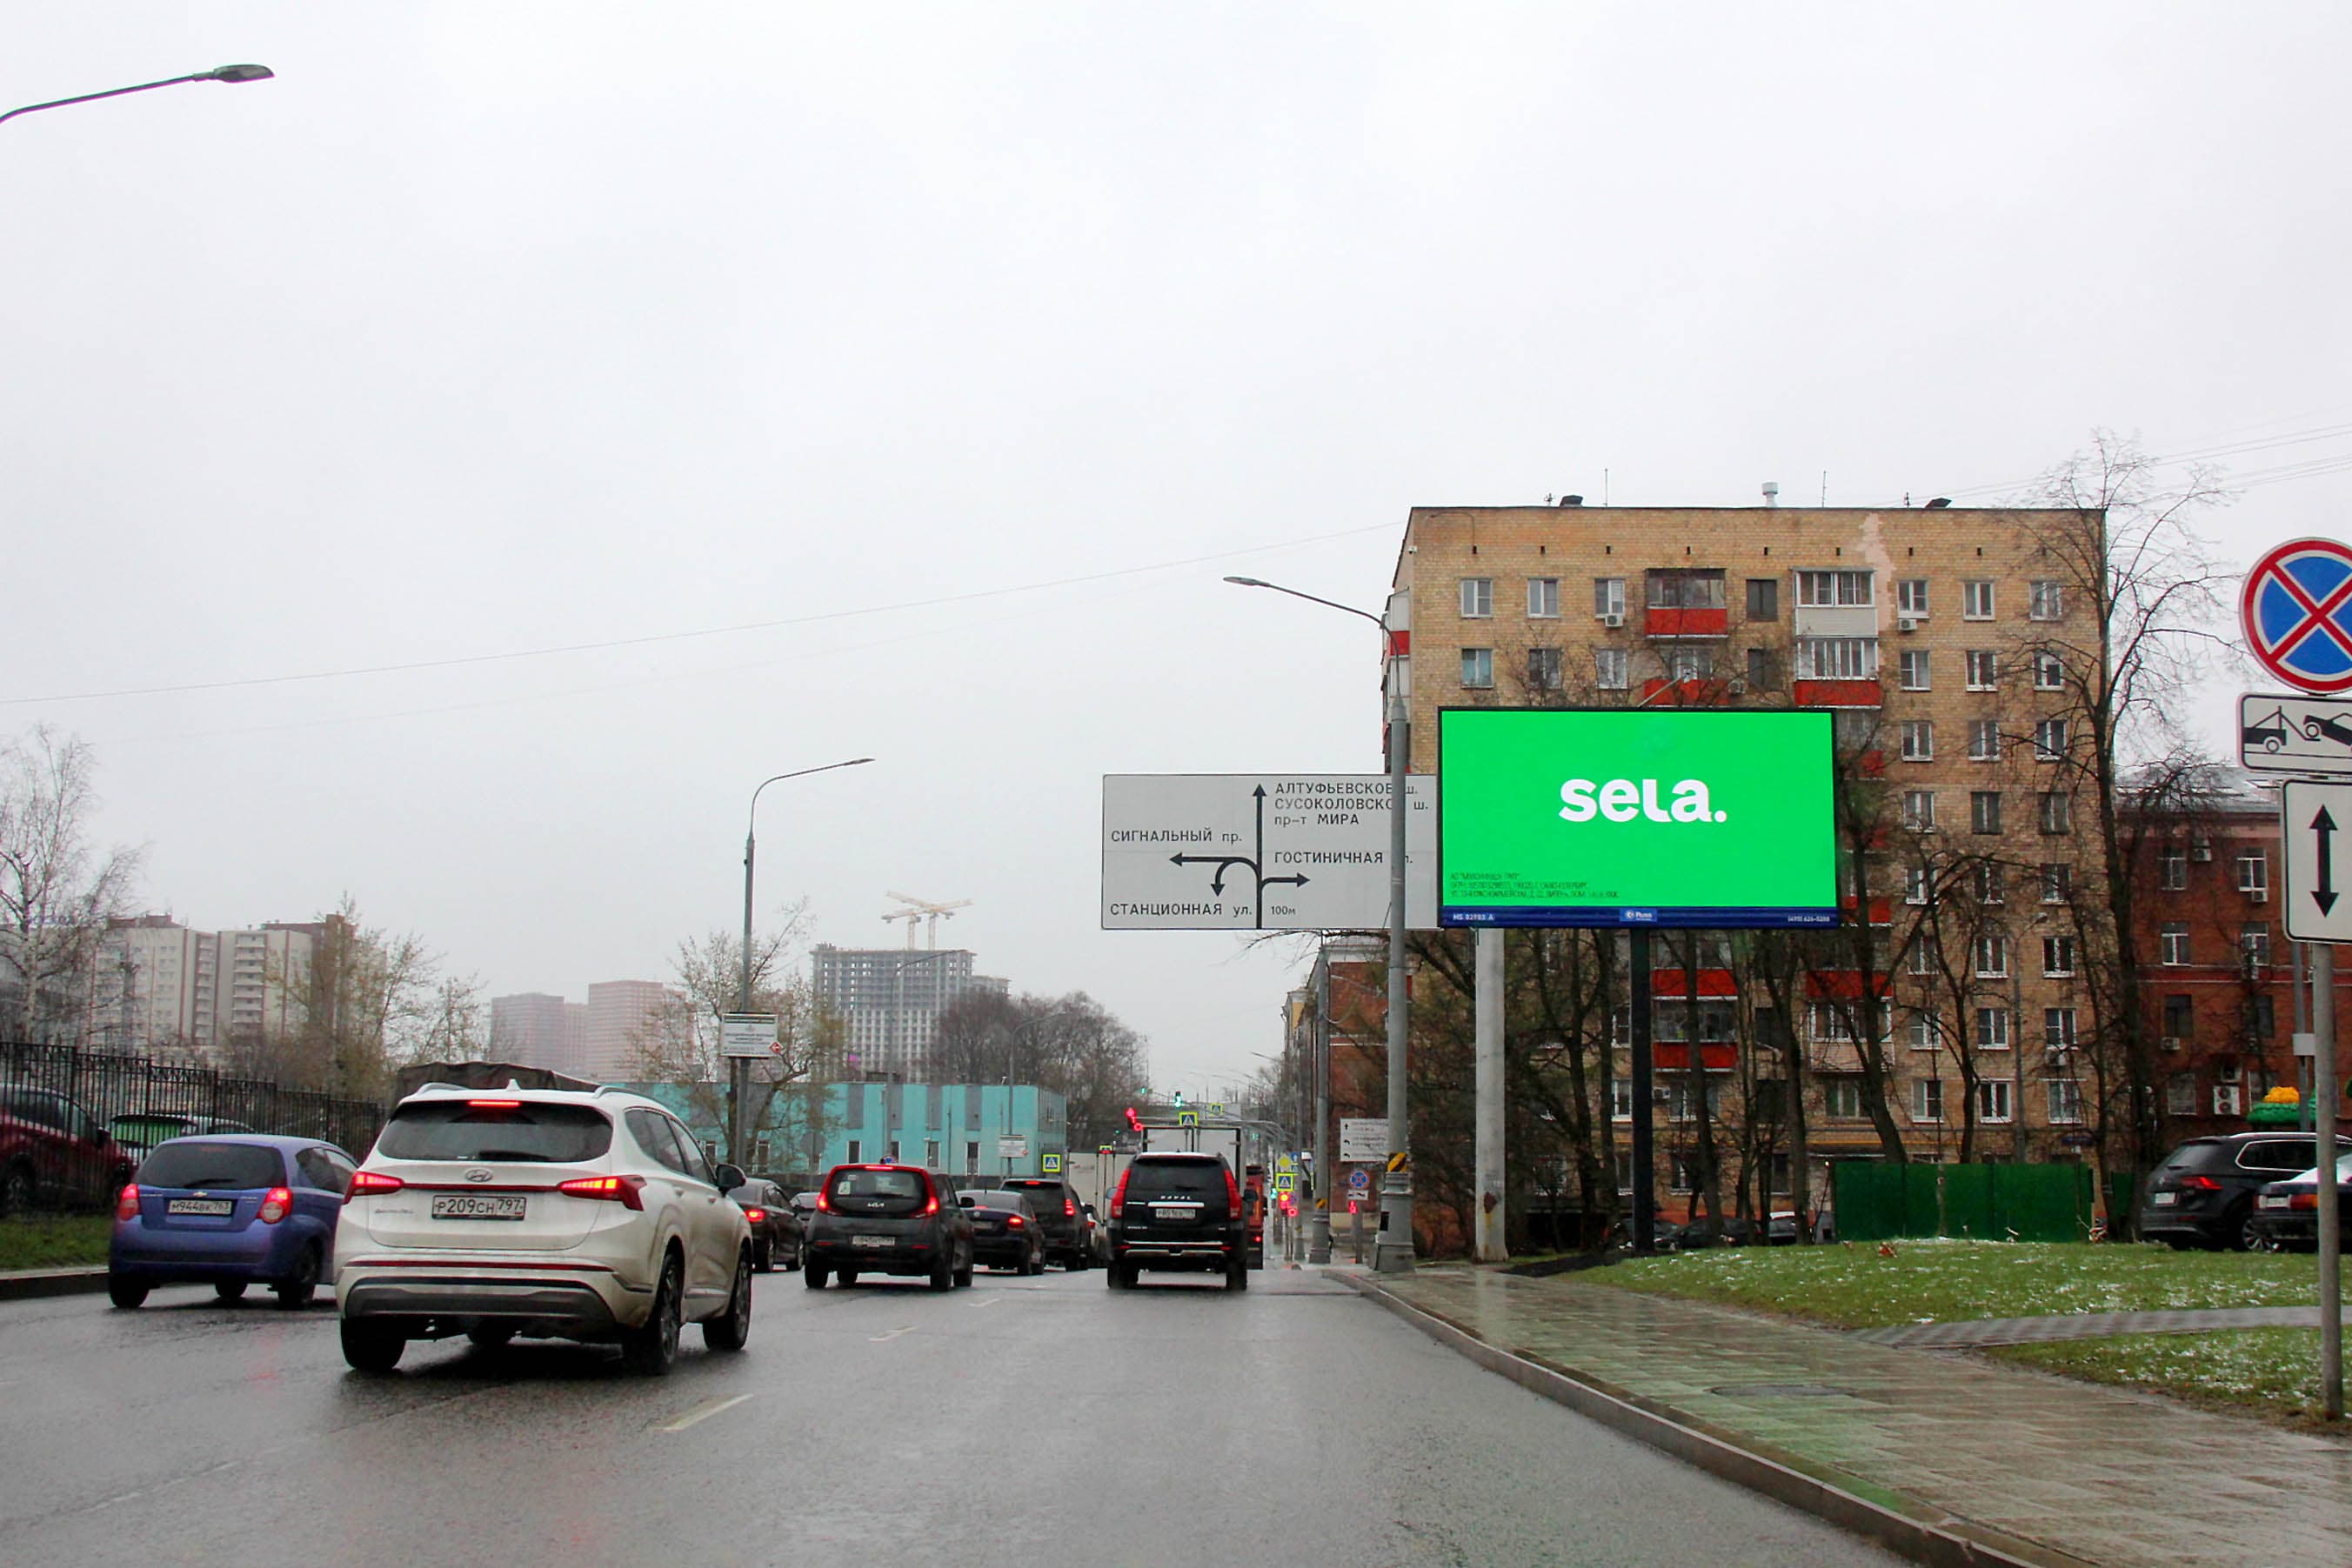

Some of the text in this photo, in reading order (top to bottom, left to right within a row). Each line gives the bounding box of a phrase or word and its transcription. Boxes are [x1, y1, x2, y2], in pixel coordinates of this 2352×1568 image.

[1275, 783, 1393, 795] АЛТУФЬЕВСКОЕ
[1274, 797, 1429, 811] СУСОКОЛОВСКО ш.
[1558, 778, 1727, 823] sela.
[1274, 814, 1360, 828] пр-т МИРА
[1111, 827, 1243, 845] СИГНАЛЬНЫЙ пр.
[1274, 851, 1383, 864] ГОСТИНИЧНАЯ
[1110, 904, 1253, 917] СТАНЦИОННАЯ ул.
[1271, 905, 1296, 916] 100м
[497, 1198, 522, 1211] 797
